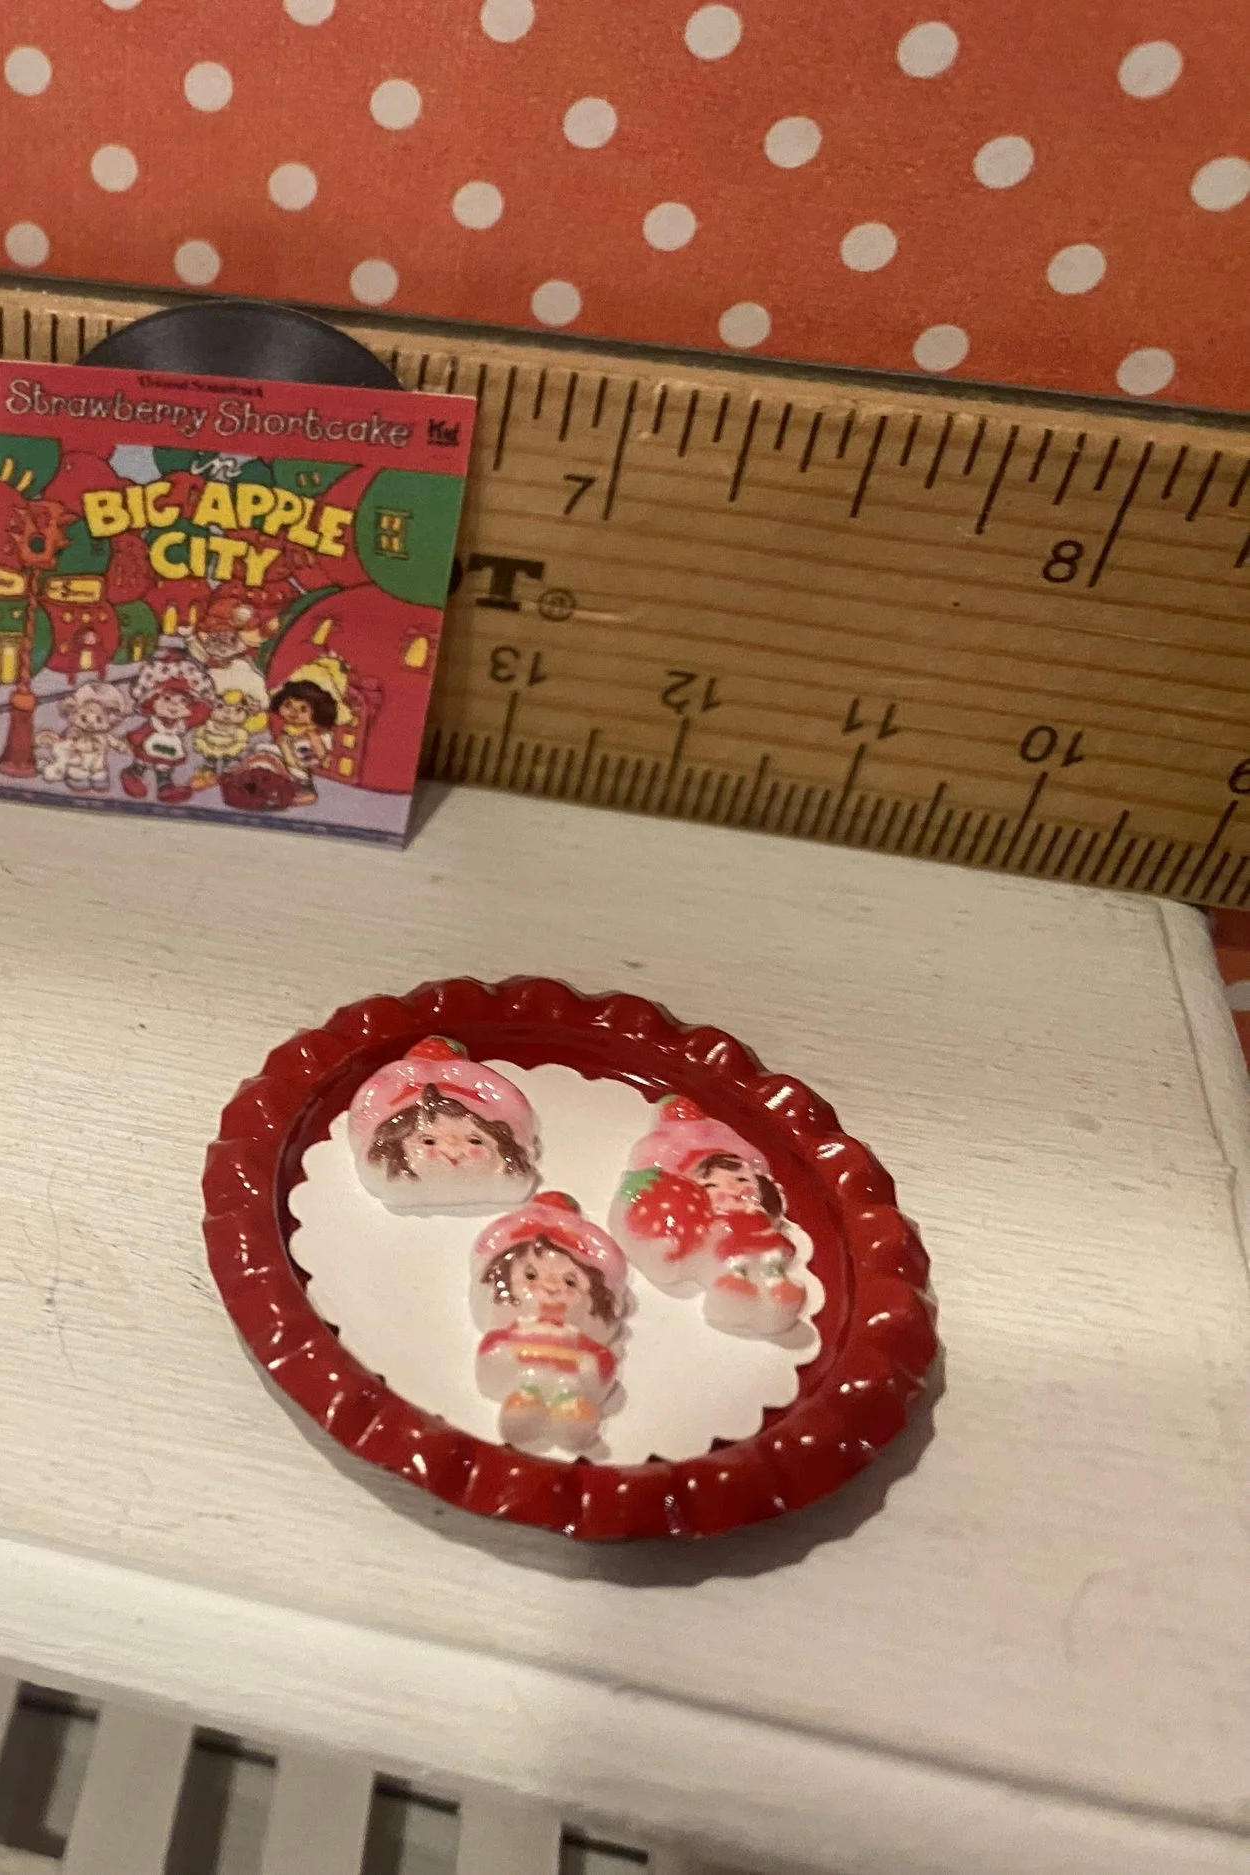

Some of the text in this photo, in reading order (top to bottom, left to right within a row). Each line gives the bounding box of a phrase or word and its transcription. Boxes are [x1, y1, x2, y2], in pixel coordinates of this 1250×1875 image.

[5, 378, 413, 448] Strawberry Shortcake
[82, 481, 354, 558] BIG APPLE
[562, 473, 598, 516] 7
[1040, 538, 1086, 585] 8
[149, 531, 282, 587] CITY
[489, 645, 548, 687] 13
[659, 668, 724, 714] 12
[841, 697, 899, 740] 11
[1018, 724, 1085, 768] 10
